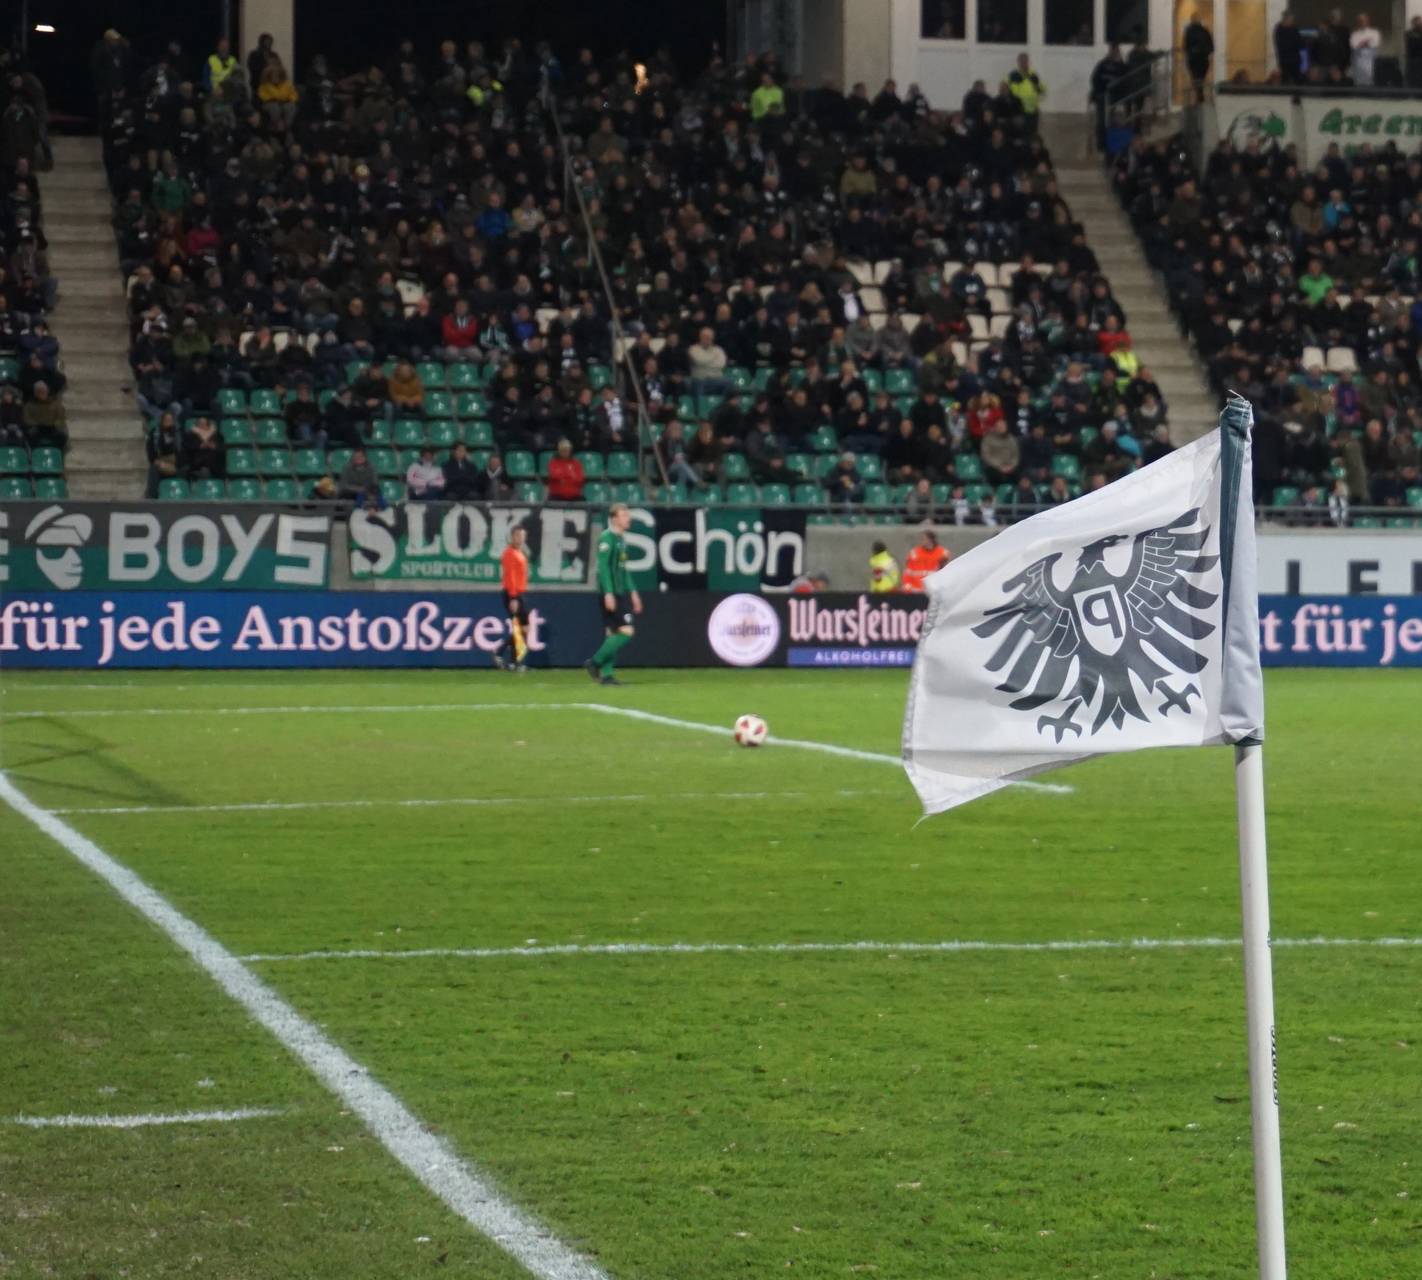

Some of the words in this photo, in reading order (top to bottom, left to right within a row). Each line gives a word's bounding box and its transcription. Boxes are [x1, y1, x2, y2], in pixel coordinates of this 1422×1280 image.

[108, 511, 330, 586] BOYS
[350, 503, 587, 581] SLOKE
[400, 560, 495, 578] SPORTCLUB
[0, 600, 90, 651] für
[98, 600, 222, 666] jede
[232, 600, 547, 652] Anstoßzet
[1291, 603, 1374, 652] für
